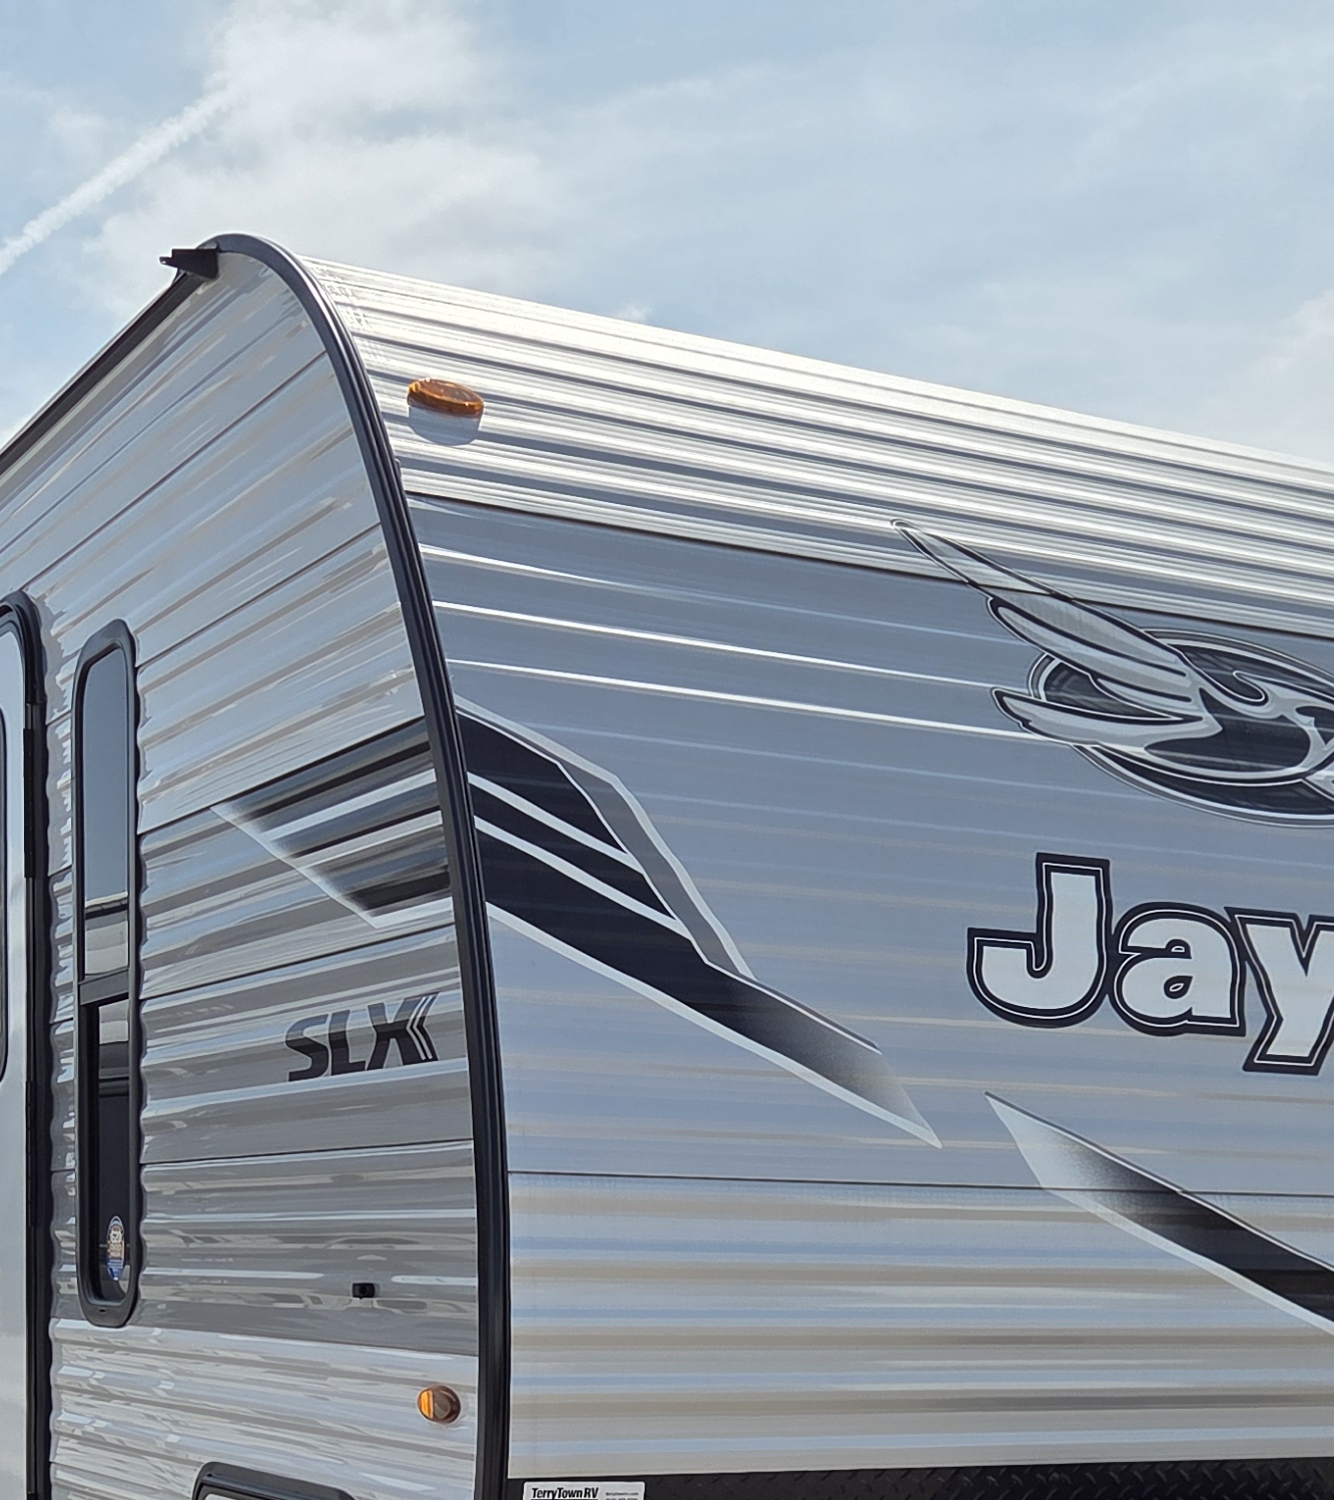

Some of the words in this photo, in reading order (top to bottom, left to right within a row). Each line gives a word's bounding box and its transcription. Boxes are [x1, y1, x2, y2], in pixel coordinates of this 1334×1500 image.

[284, 991, 440, 1082] SLX
[531, 1487, 583, 1500] TerryTown
[583, 1487, 599, 1499] RV
